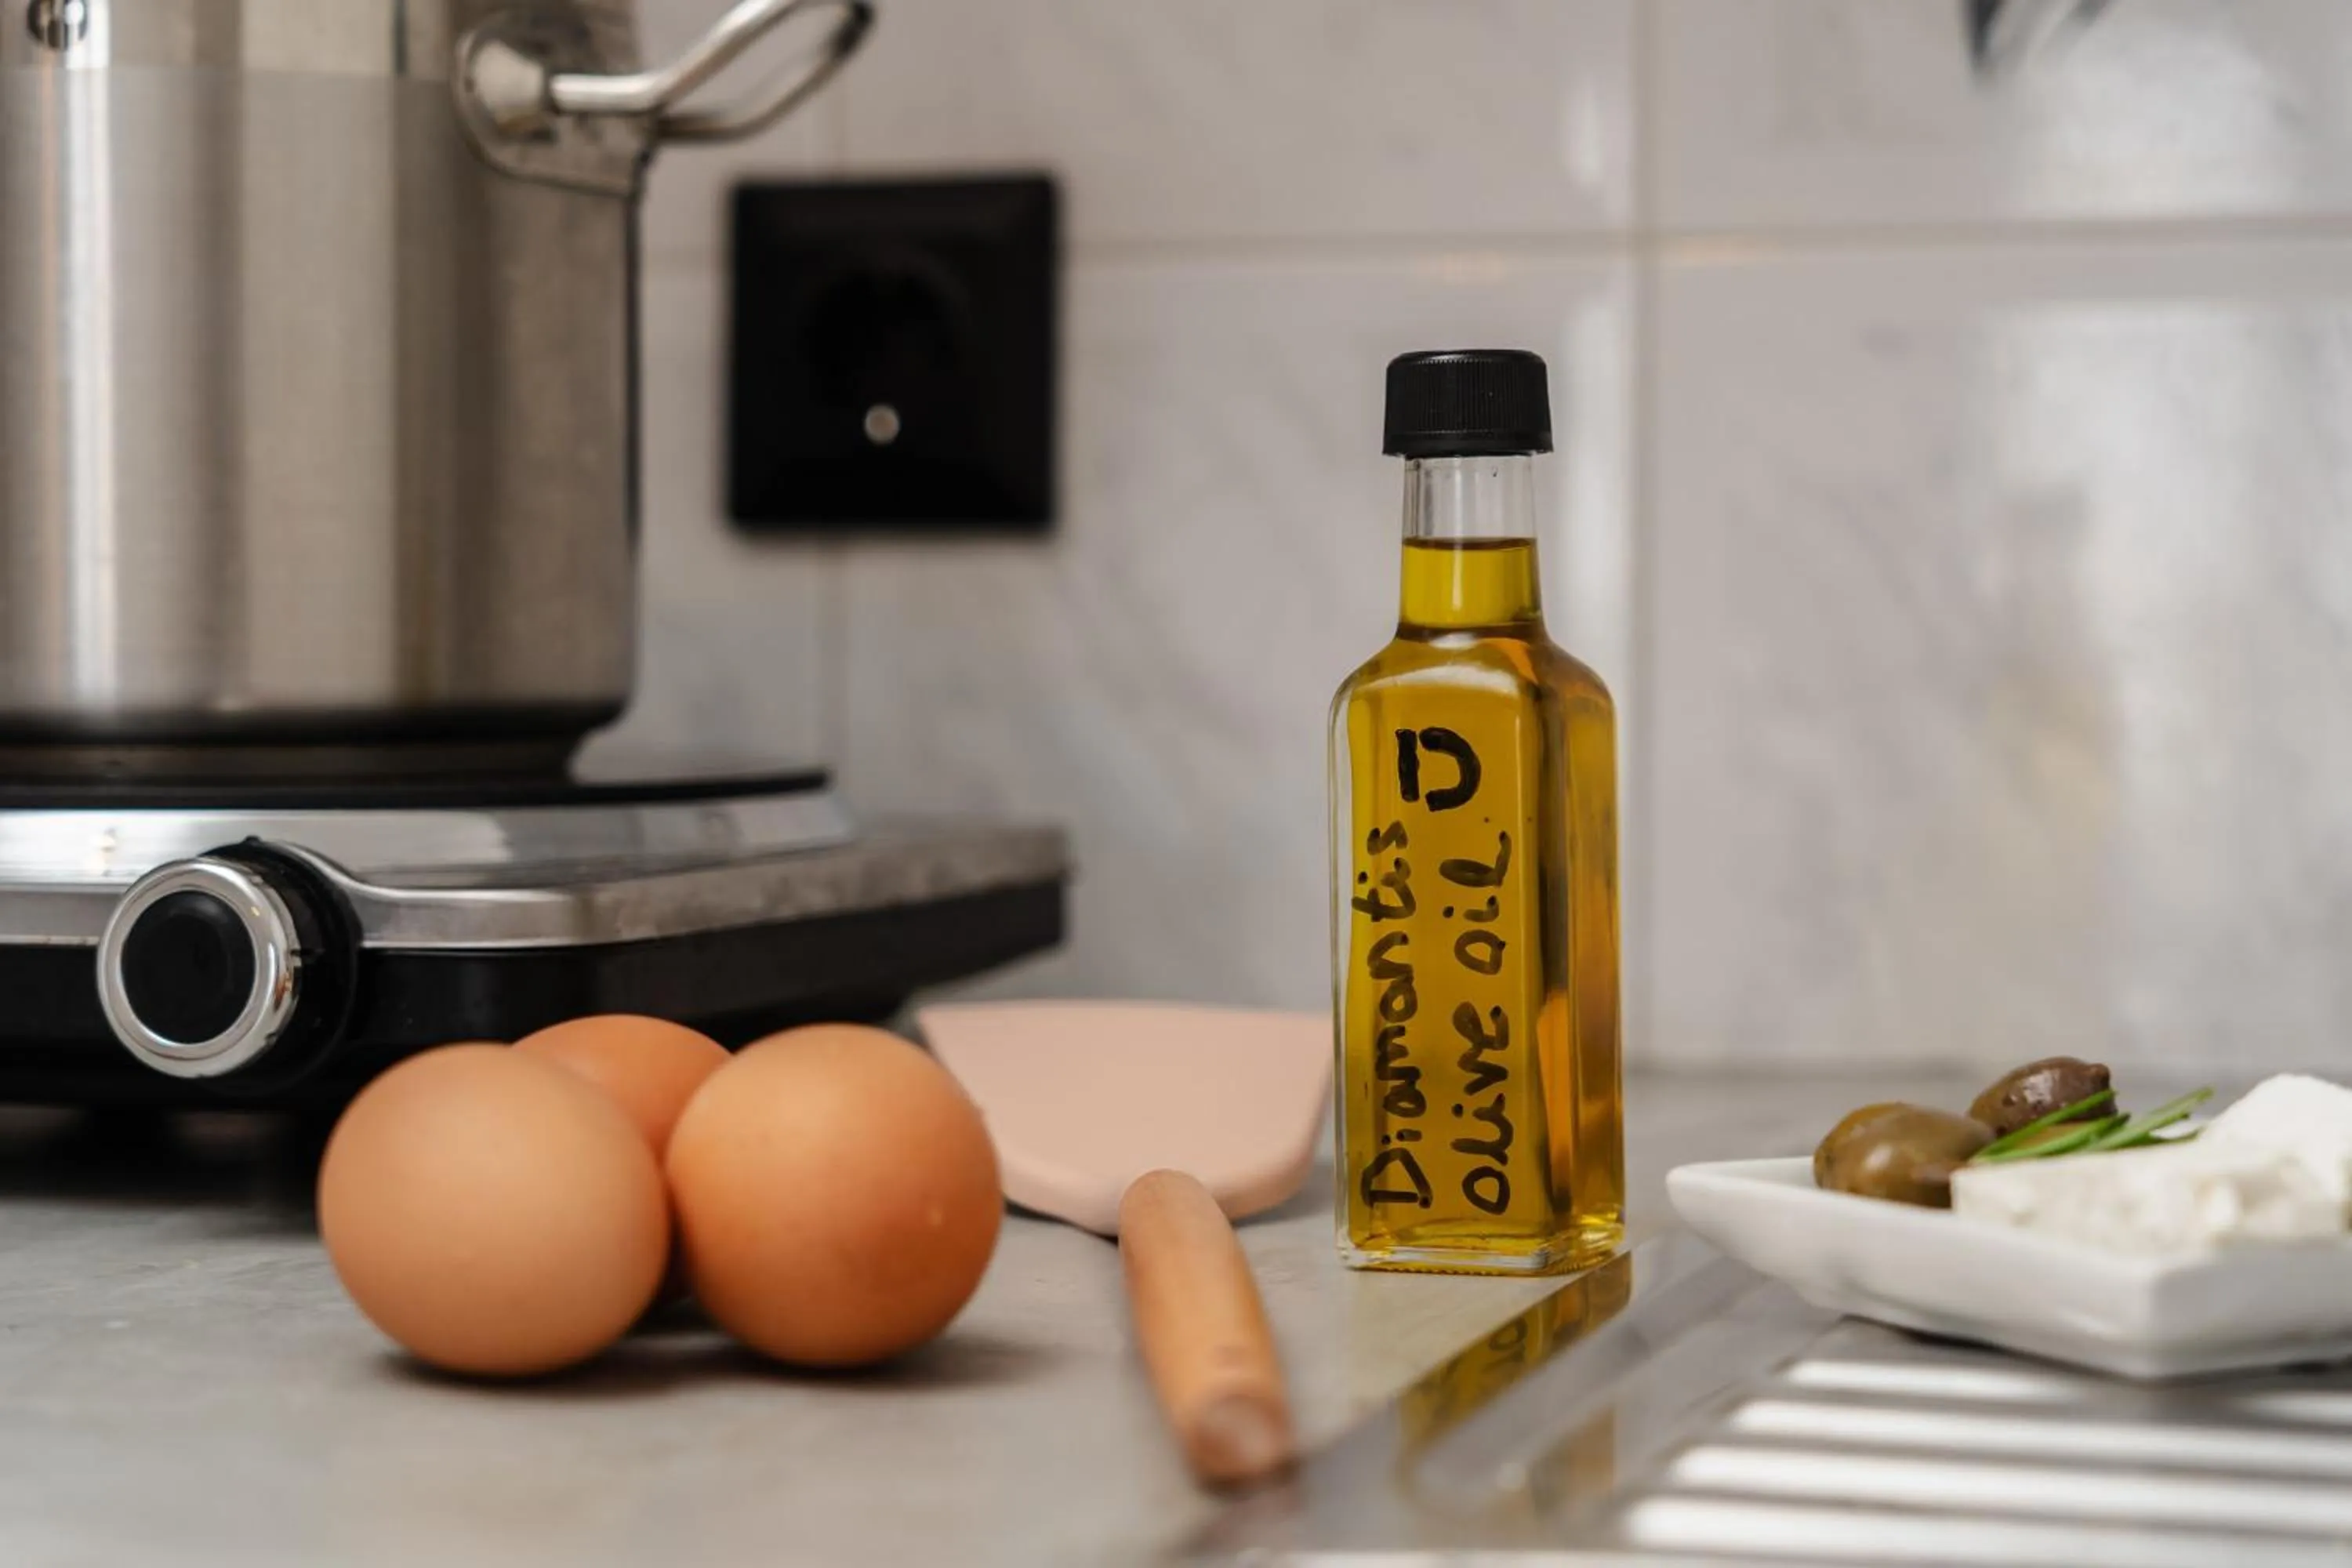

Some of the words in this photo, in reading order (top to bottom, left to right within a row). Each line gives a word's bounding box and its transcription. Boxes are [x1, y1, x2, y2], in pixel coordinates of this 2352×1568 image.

[1395, 727, 1482, 812] D
[1439, 829, 1512, 975] oil
[1352, 820, 1433, 1209] Diamantis
